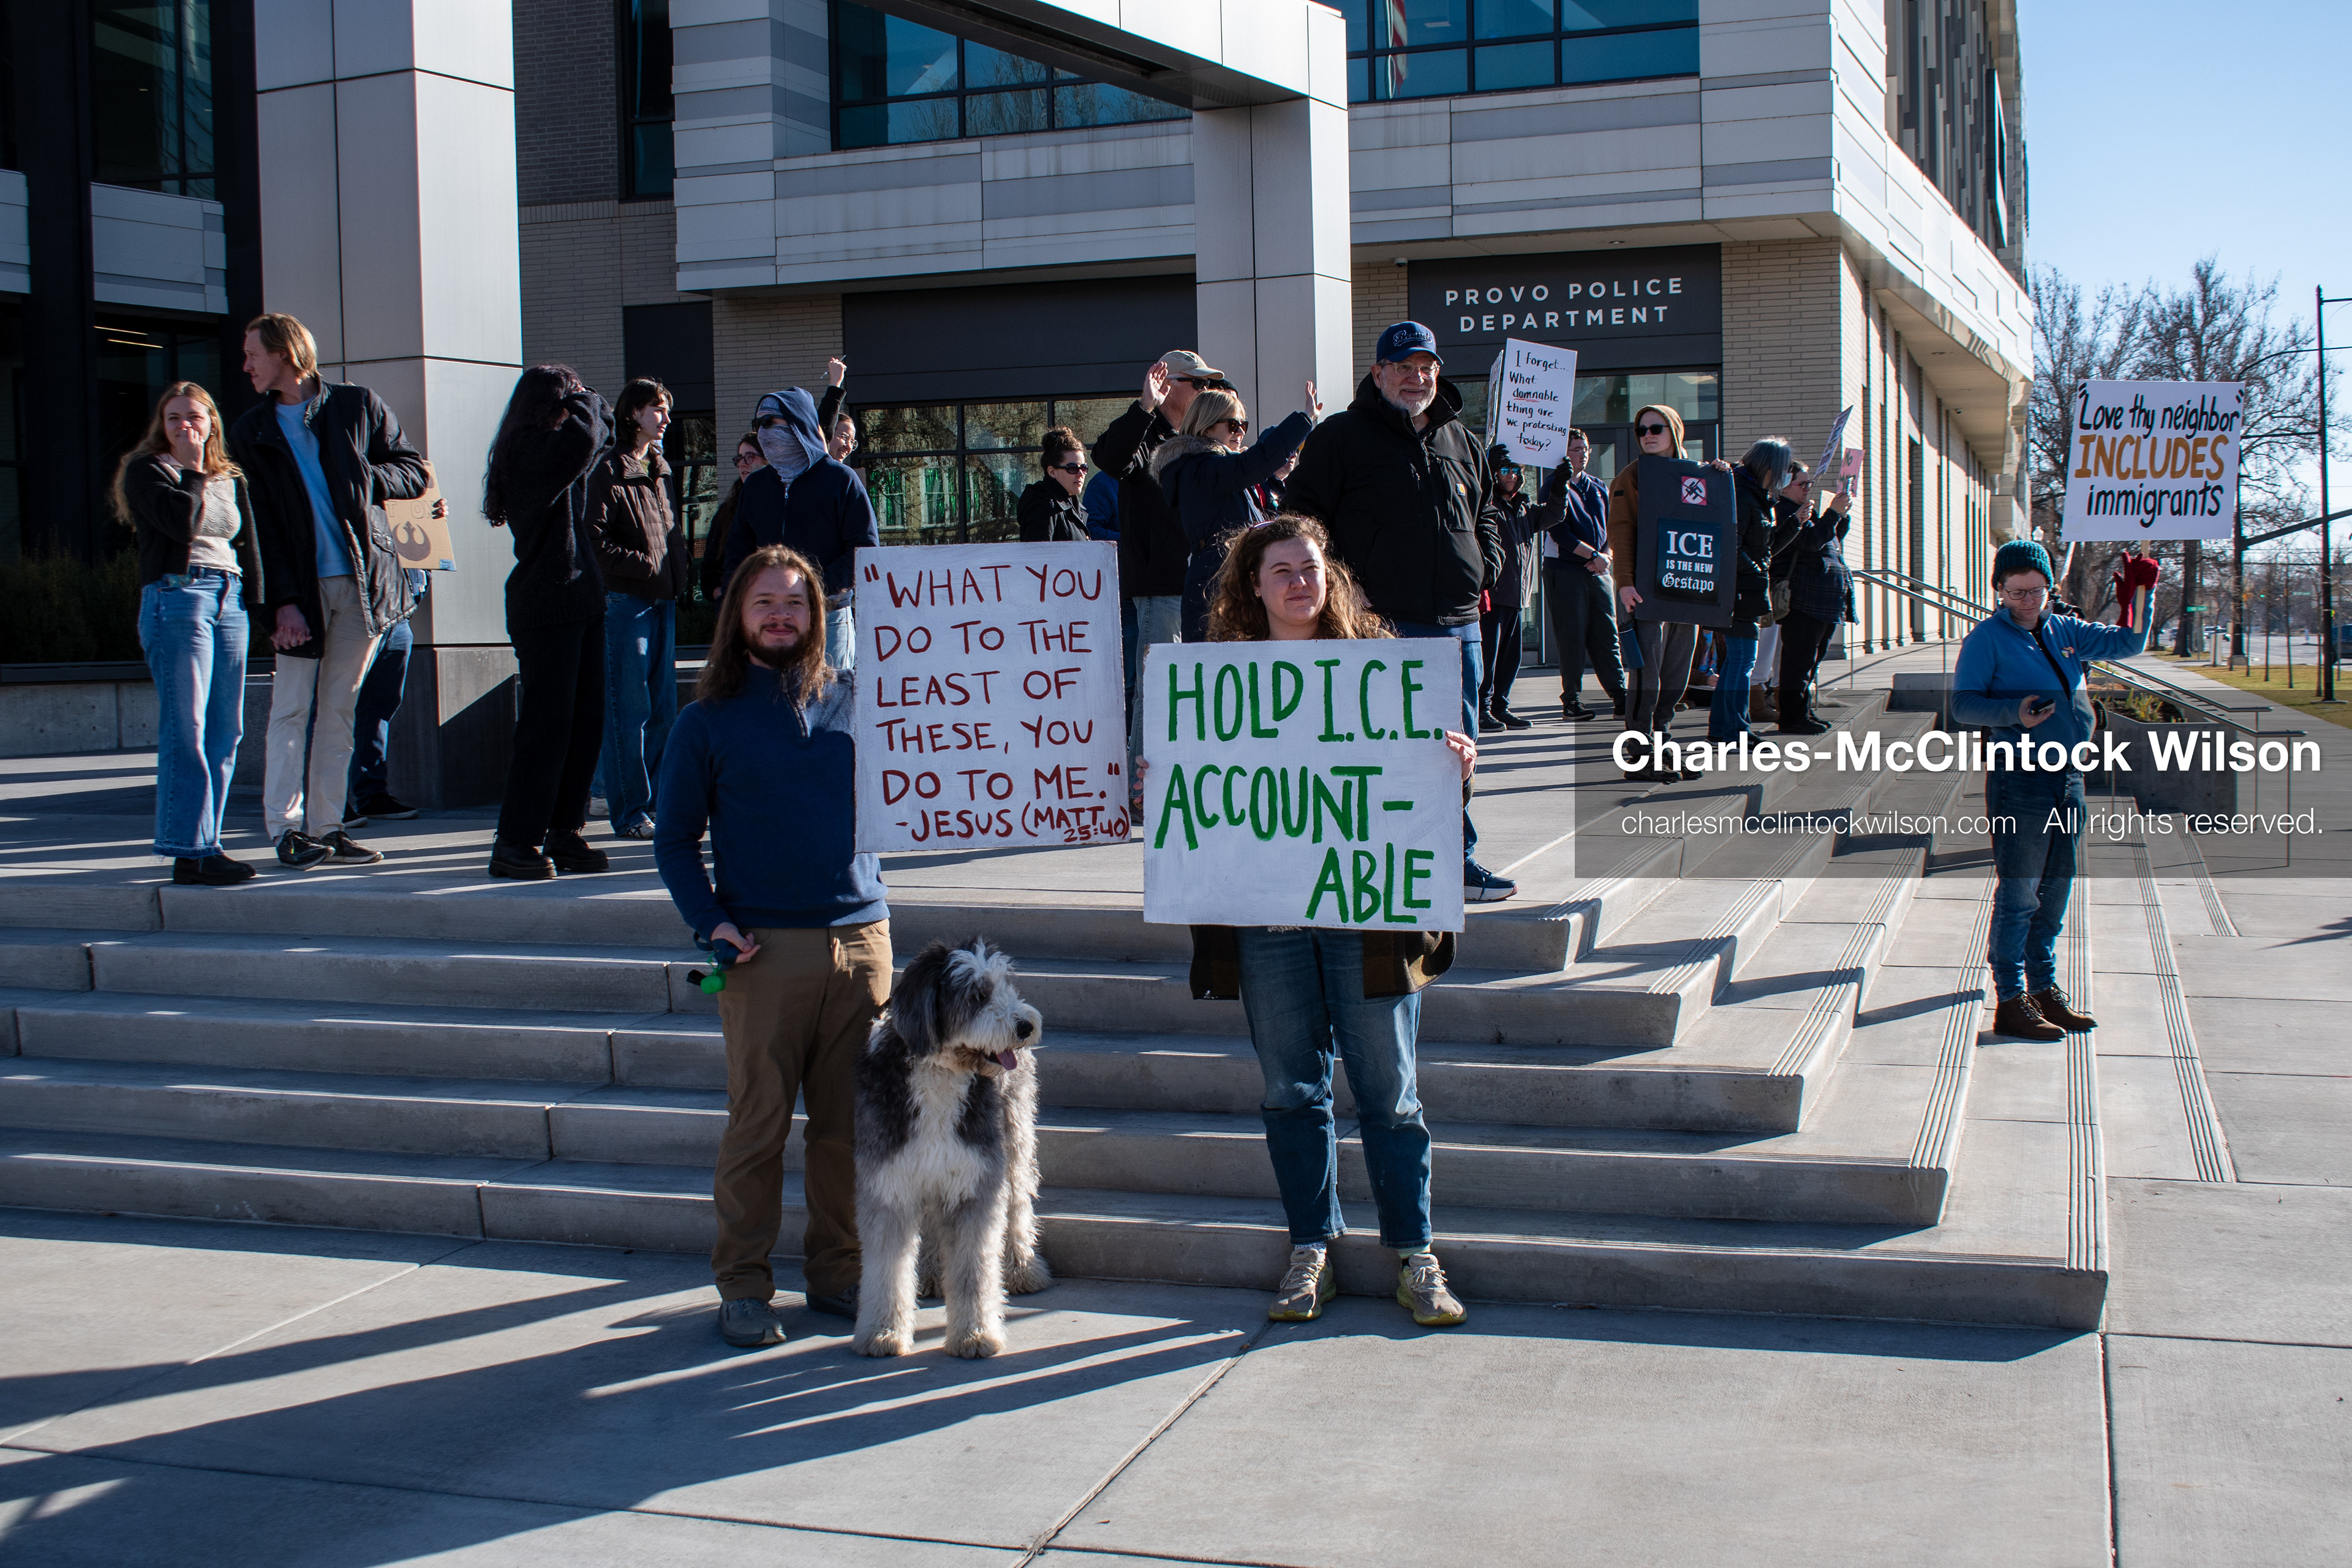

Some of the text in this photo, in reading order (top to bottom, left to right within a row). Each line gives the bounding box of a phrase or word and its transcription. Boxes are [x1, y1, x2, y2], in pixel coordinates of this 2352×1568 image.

[1446, 277, 1682, 306] PROVO POLICE
[1460, 306, 1668, 333] DEPARTMENT
[1516, 350, 1521, 368] I
[1509, 371, 1537, 385] What
[1512, 387, 1559, 402] damnable
[1506, 400, 1554, 418] thing are
[2128, 393, 2155, 439] thy
[2160, 388, 2244, 440] neighbor"
[1516, 432, 1551, 451] today?
[1522, 420, 1567, 436] protesting
[2074, 434, 2230, 481] INCLUDES
[2086, 480, 2224, 529] immigrants
[1666, 530, 1714, 559] ICE
[1662, 572, 1714, 594] Gestapo
[1666, 559, 1713, 573] IS THE NEW
[864, 564, 1101, 608] "WHAT YOU
[874, 619, 1092, 662] DO TO THE
[877, 667, 1082, 708] LEAST OF
[1168, 658, 1443, 742] HOLD I.C.E.
[875, 715, 1093, 754] THESE, YOU
[882, 762, 1120, 806] DO TO ME."
[1154, 763, 1414, 851] ACCOUNT-
[1304, 842, 1434, 924] ABLE
